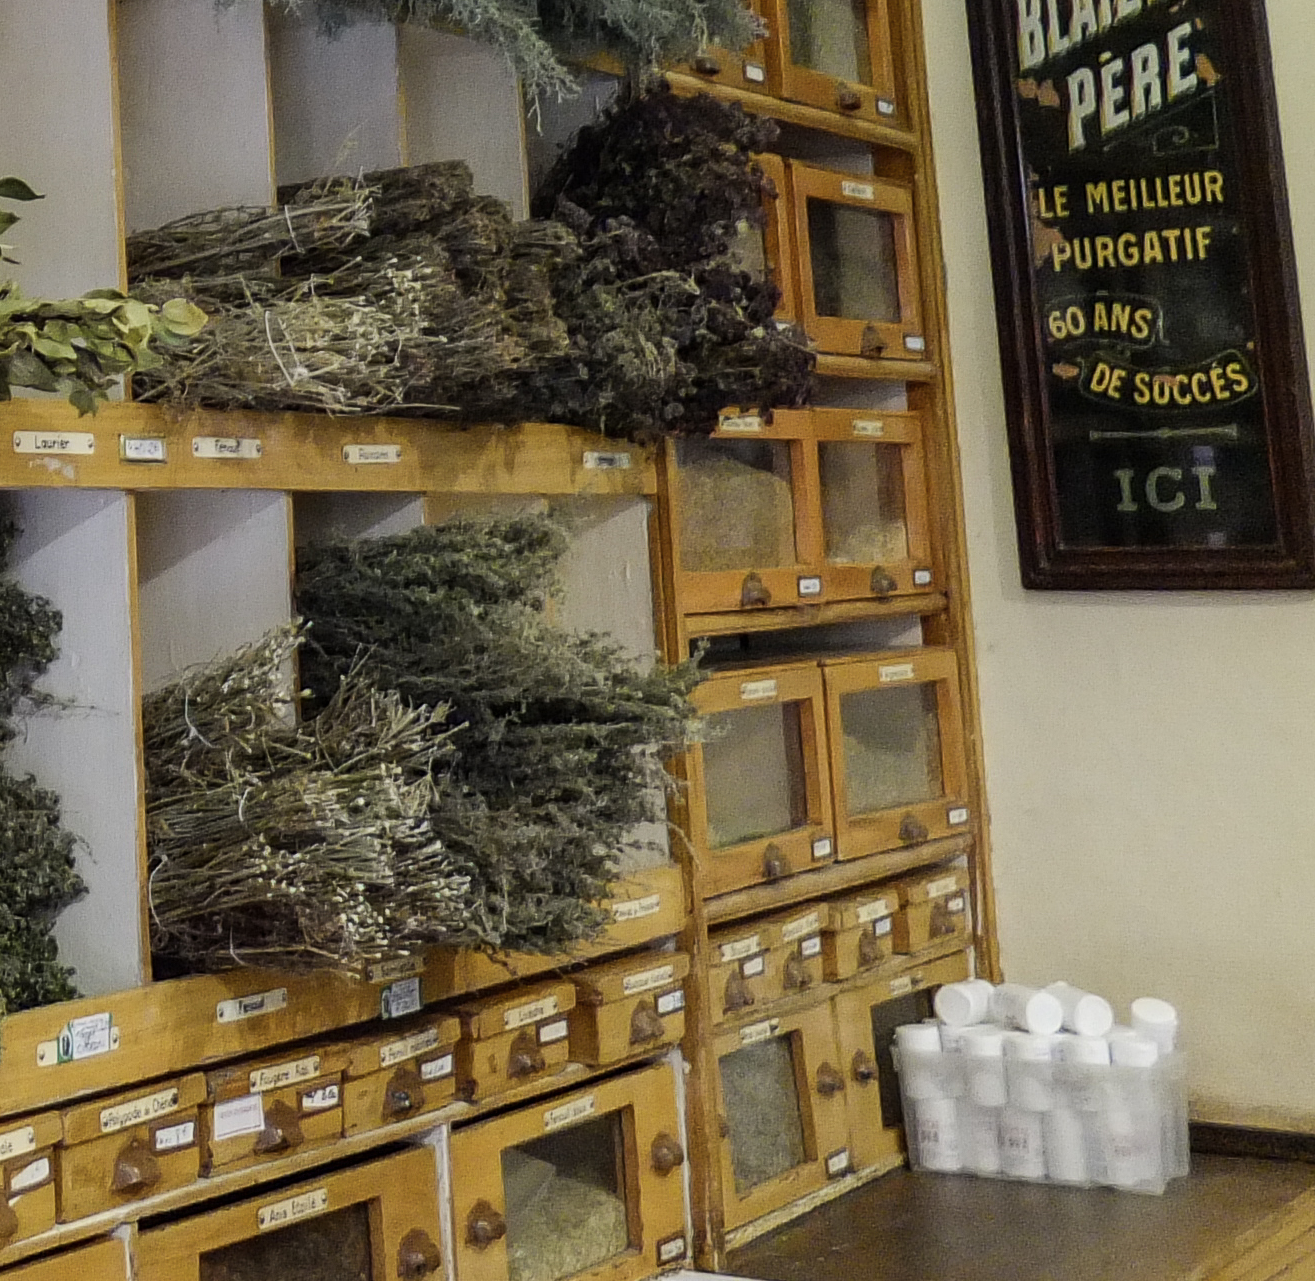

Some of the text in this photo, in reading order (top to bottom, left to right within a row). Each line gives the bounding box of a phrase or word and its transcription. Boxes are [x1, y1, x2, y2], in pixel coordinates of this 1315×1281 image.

[1039, 170, 1224, 219] LE MEILLEUR
[1051, 225, 1212, 272] PURGATIF
[1048, 302, 1152, 339] 60 ANS
[1089, 362, 1124, 399] DE
[34, 434, 70, 450] Laurier
[1113, 465, 1218, 513] ICI
